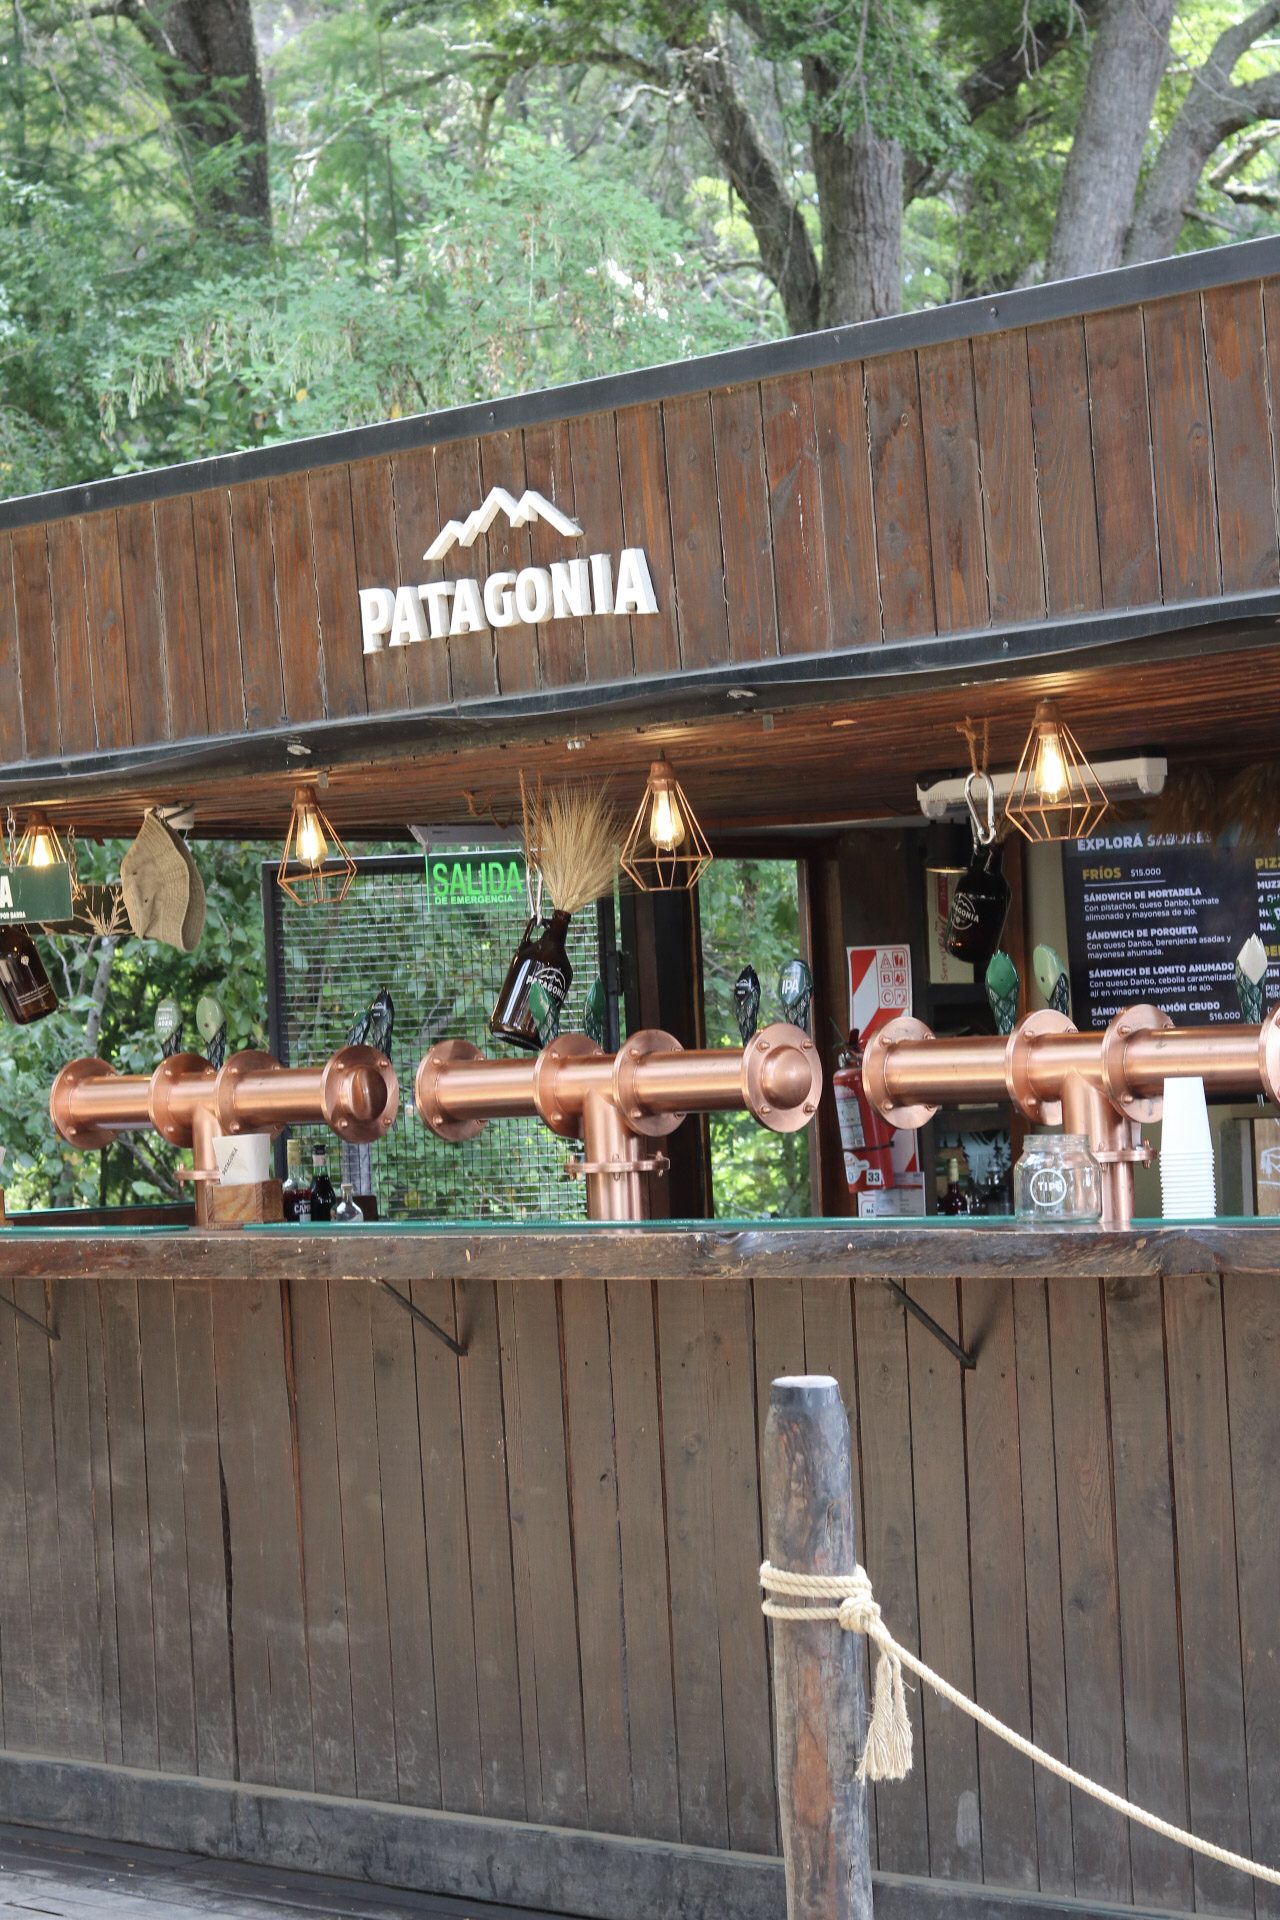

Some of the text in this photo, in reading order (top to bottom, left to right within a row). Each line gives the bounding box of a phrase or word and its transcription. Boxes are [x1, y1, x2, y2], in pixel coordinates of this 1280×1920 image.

[358, 548, 659, 654] PATAGONIA
[1077, 833, 1143, 851] EXPLORÁ
[433, 861, 523, 896] SALIDA
[1082, 865, 1121, 880] FRÍOS
[435, 895, 514, 905] DE EMERGENCIA
[1084, 887, 1202, 902] SÁNDWICH DE MORTADELA
[1085, 904, 1099, 912] Con
[1140, 900, 1161, 909] queso
[1192, 897, 1220, 906] tomate
[1126, 912, 1130, 920] y
[1132, 909, 1169, 919] mayonesa
[1171, 908, 1182, 916] de
[1086, 926, 1198, 940] SÁNDWICH DE PORQUETA
[1087, 942, 1102, 950] Con
[1103, 941, 1126, 949] queso
[1156, 937, 1198, 946] berenjenas
[1199, 935, 1225, 944] asadas
[1227, 935, 1232, 943] y
[1087, 950, 1125, 960] mayonesa
[1089, 962, 1235, 978] SÁNDWICH DE LOMITO AHUMADO
[883, 974, 891, 983] B
[1090, 980, 1104, 988] Con
[1106, 979, 1129, 988] queso
[1158, 975, 1185, 985] cebolla
[781, 980, 800, 995] IPA
[1101, 989, 1111, 997] en
[1112, 987, 1140, 997] vinagre
[1141, 987, 1146, 995] y
[1148, 985, 1185, 995] mayonesa
[1187, 984, 1198, 992] de
[883, 991, 892, 1002] C
[1189, 1001, 1220, 1012] CRUDO
[868, 1172, 880, 1182] 33
